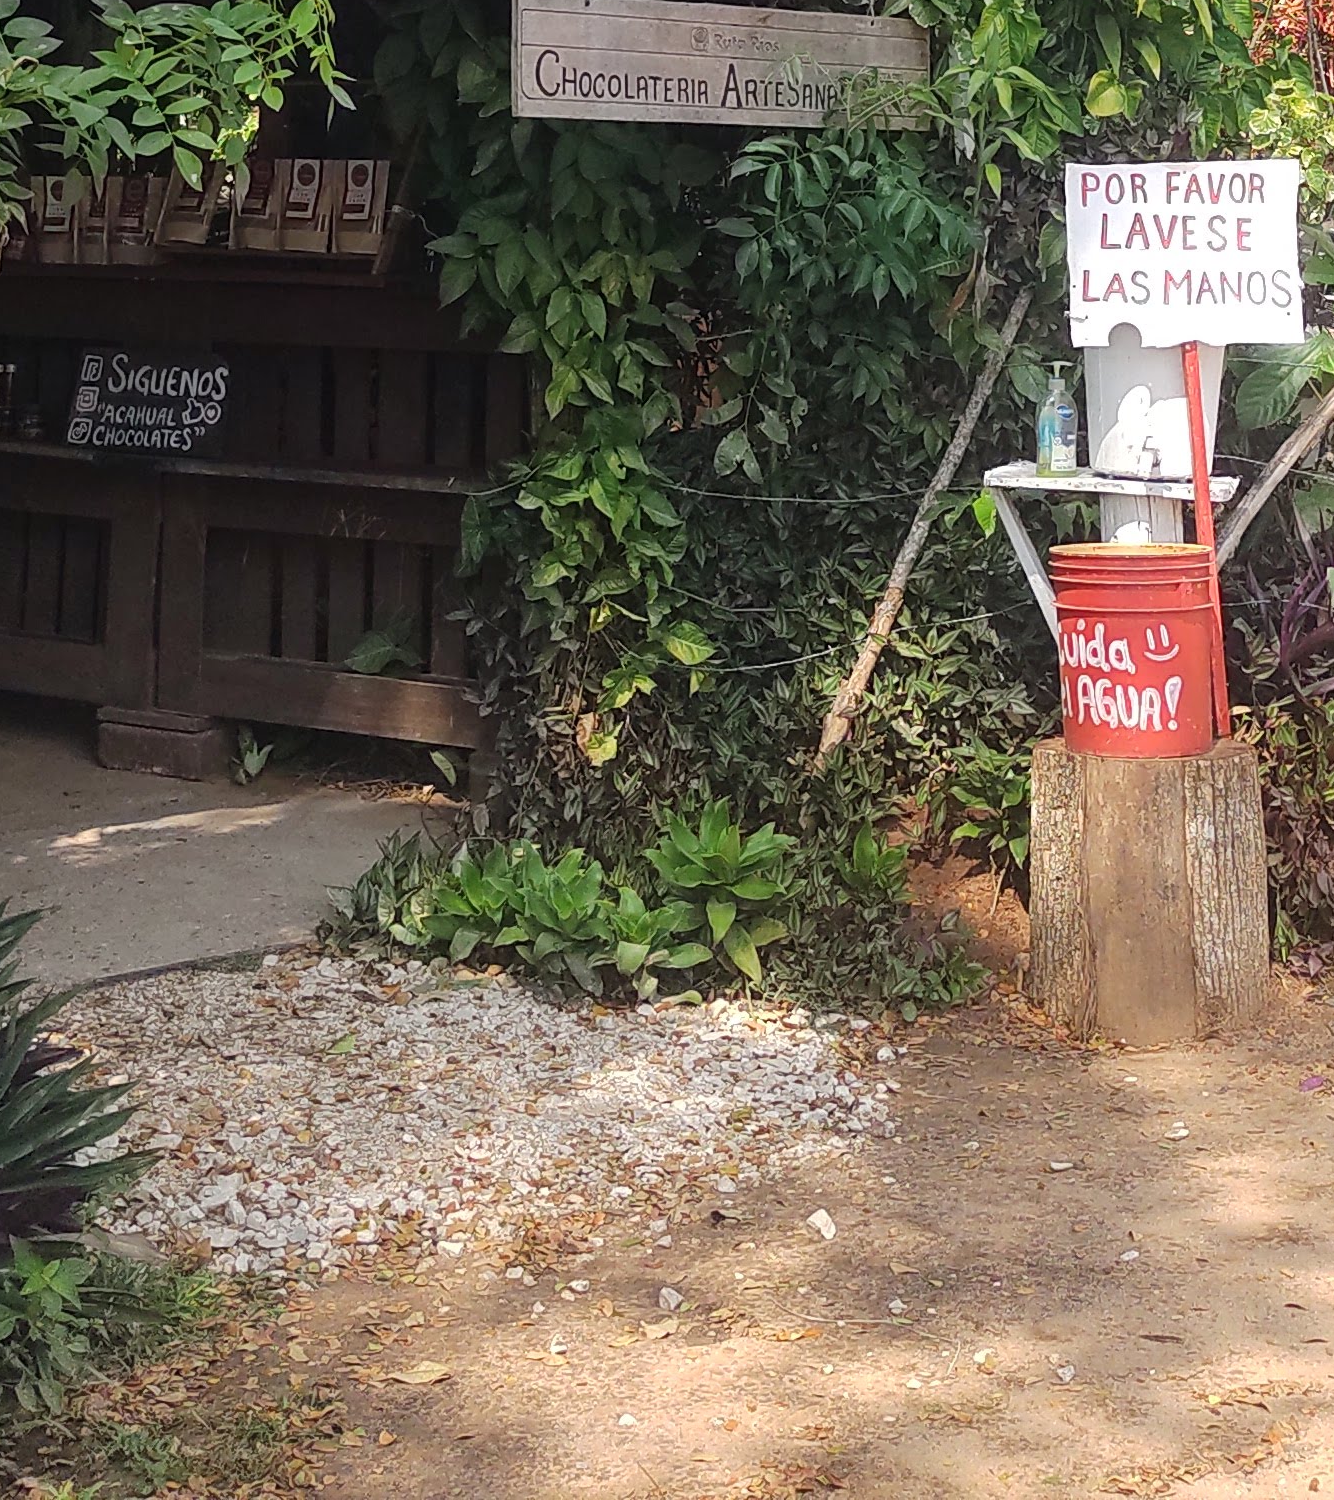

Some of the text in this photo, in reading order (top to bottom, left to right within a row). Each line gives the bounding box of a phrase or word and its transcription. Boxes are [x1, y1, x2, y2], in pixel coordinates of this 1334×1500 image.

[535, 49, 709, 106] CHOCOLATERIA
[1080, 172, 1265, 207] POR FAVOR
[1100, 212, 1252, 252] LAVESE
[1083, 268, 1292, 309] LAS MANOS
[108, 353, 229, 401] SIGUENOS
[1077, 674, 1183, 732] AGUA!
